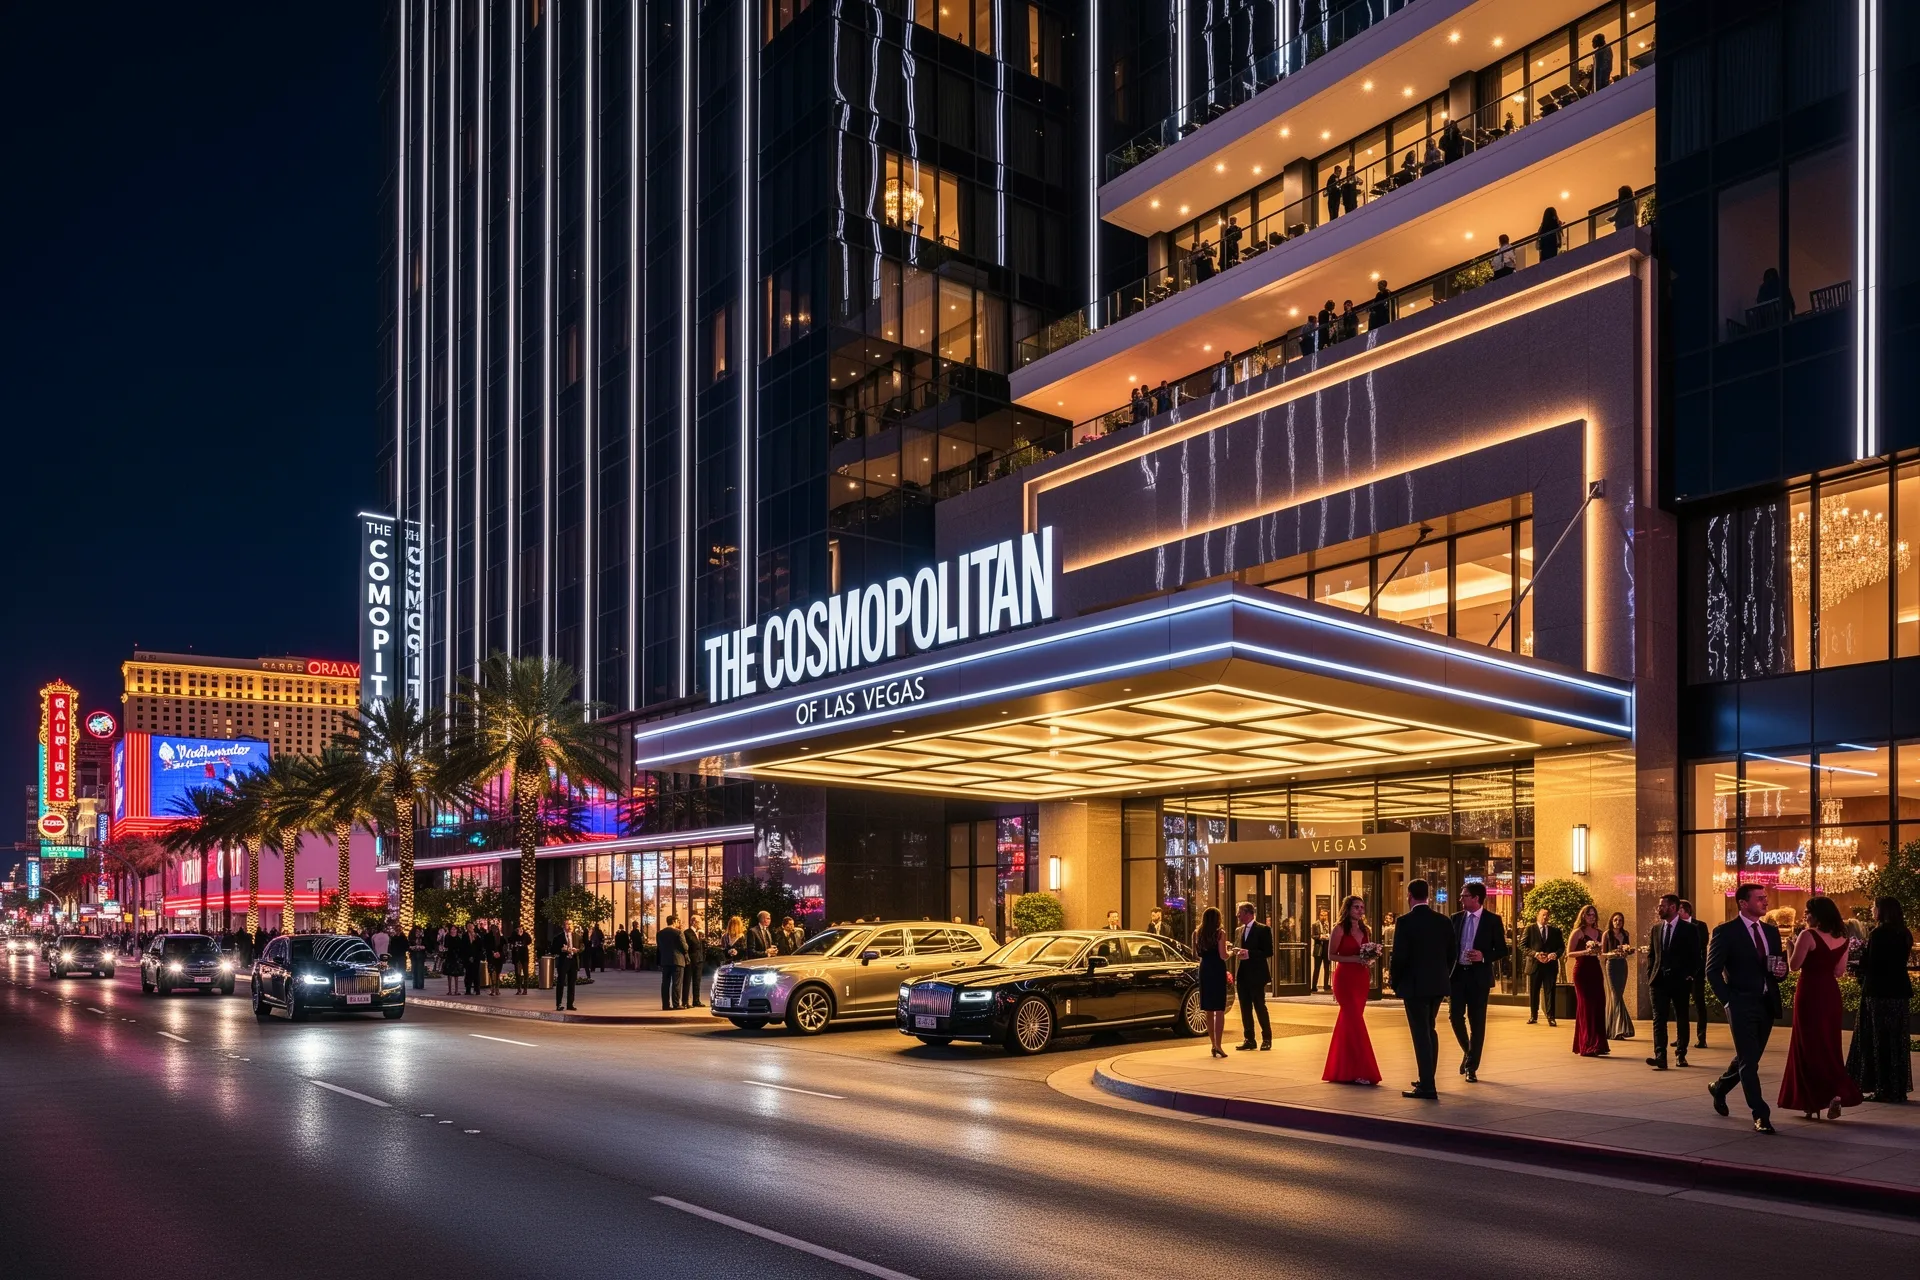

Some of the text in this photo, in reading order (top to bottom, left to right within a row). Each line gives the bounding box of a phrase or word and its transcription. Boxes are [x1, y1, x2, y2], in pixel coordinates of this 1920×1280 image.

[366, 522, 392, 536] THE
[705, 526, 1053, 703] THE COSMOPOLITAN
[796, 677, 925, 725] OF LAS VEGAS
[1311, 838, 1367, 853] VEGAS
